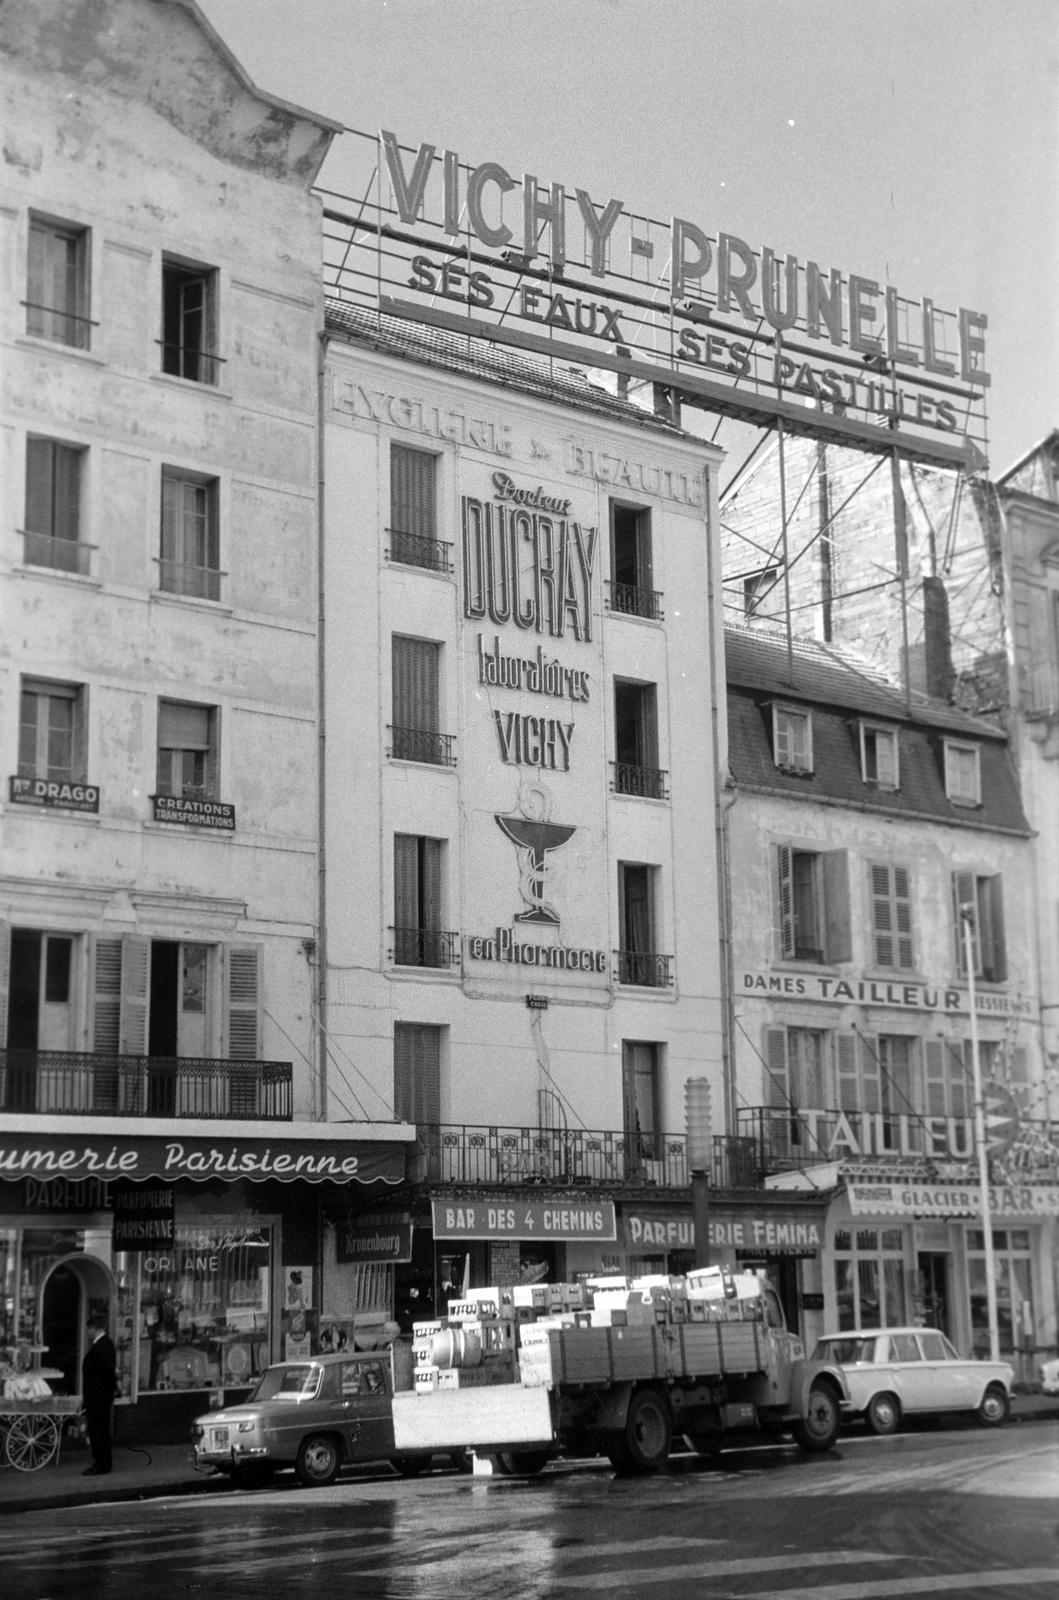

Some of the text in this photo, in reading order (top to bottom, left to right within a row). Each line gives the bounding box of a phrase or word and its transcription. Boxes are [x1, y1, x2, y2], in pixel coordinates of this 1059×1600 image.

[408, 255, 957, 431] SES EAUX SES PASTILLES
[492, 471, 572, 516] Docteur
[461, 495, 598, 643] DUCRAY
[494, 710, 575, 772] VICHY
[35, 781, 97, 802] DRAGO
[156, 808, 234, 827] TRANSFORMATIONS
[157, 798, 231, 816] CREATIONS
[470, 927, 606, 973] en Pharmacie
[744, 974, 806, 993] DAMES
[817, 978, 961, 1009] TAILLEUR
[164, 1143, 359, 1175] Parisienne
[116, 1189, 173, 1209] PARFUMERIE
[902, 1191, 970, 1207] GLACIER
[988, 1189, 1034, 1210] BAR
[116, 1219, 173, 1239] PARISIENNE
[446, 1208, 603, 1231] BAR DES 4 CHEMINS
[345, 1232, 401, 1255] Kronenbourg
